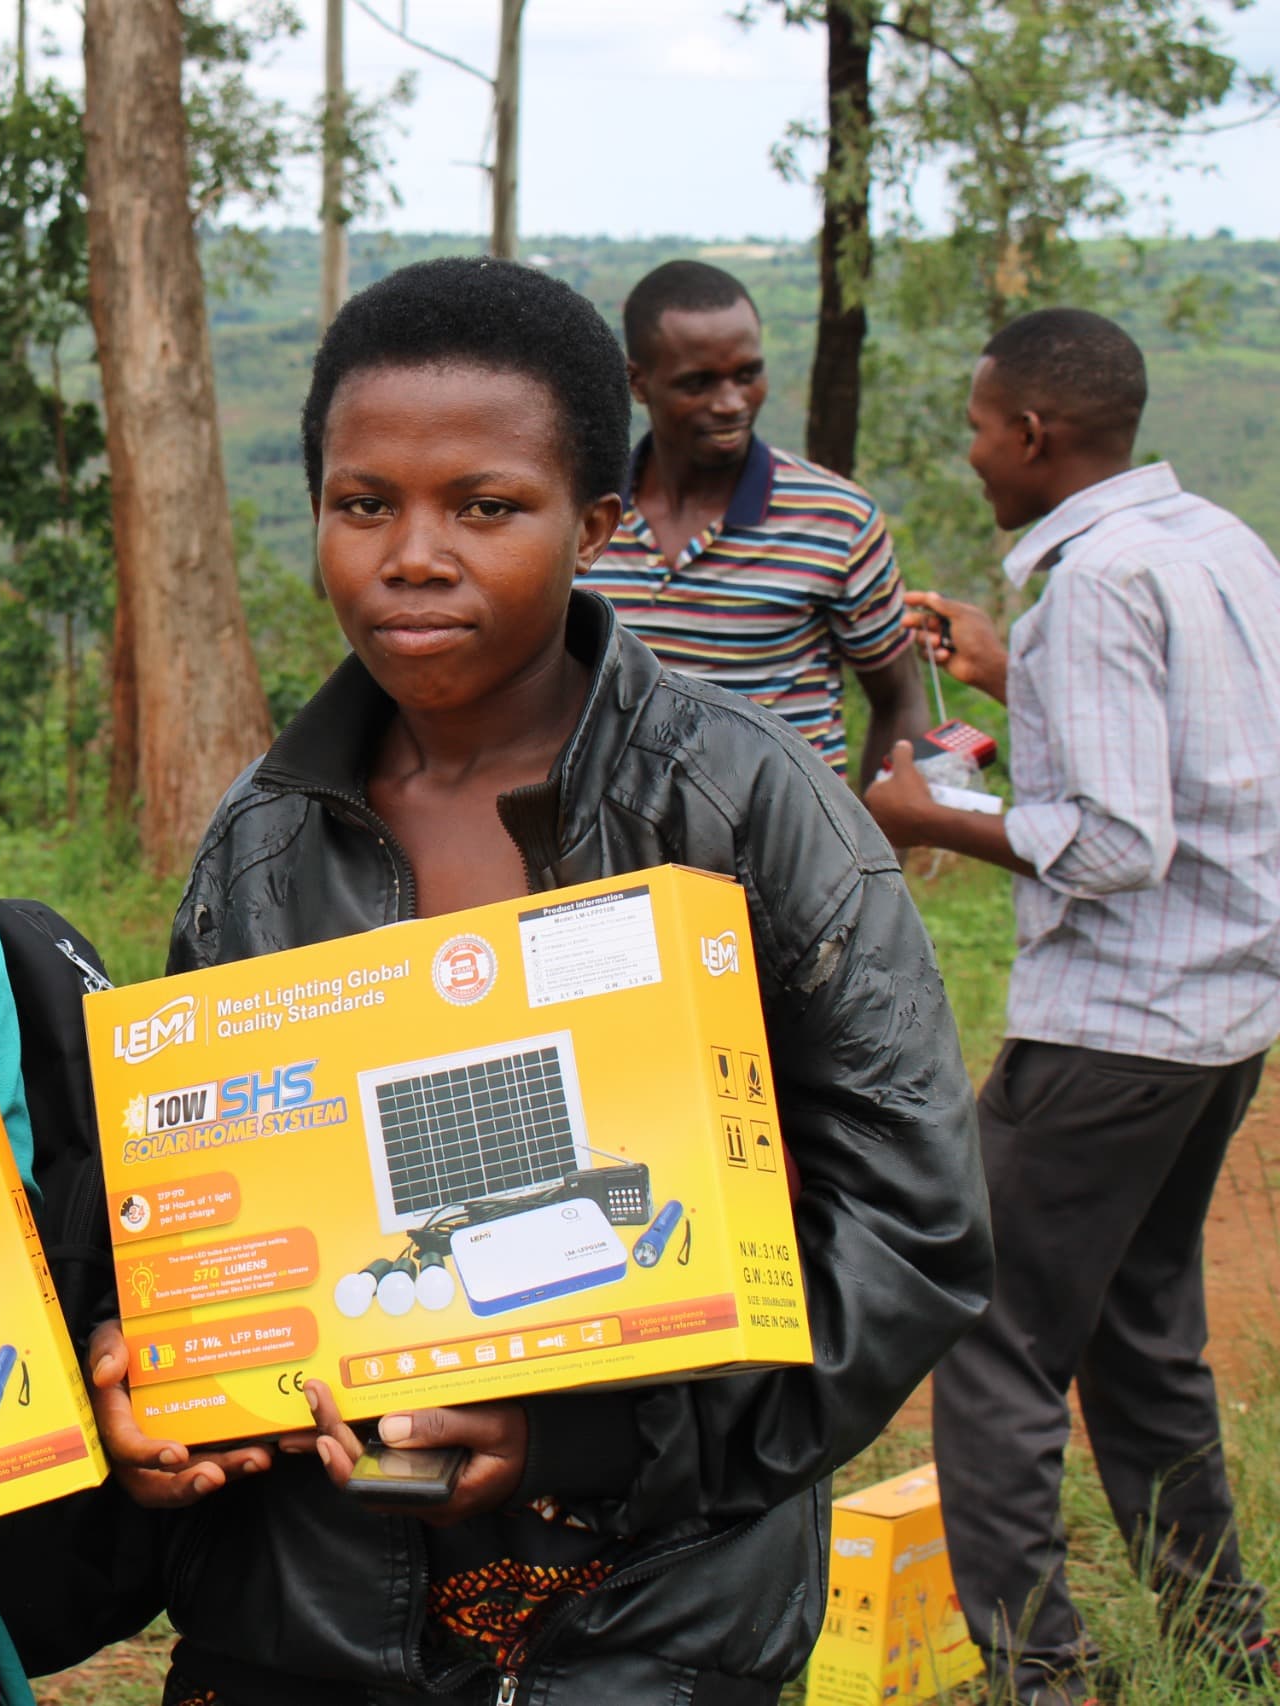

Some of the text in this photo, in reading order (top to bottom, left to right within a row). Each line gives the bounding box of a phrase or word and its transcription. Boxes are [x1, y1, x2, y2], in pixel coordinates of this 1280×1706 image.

[543, 893, 624, 916] Product information
[700, 930, 740, 976] LEMI
[217, 960, 410, 1018] Meet Lighting Global
[217, 989, 385, 1038] Quality Standards
[113, 995, 200, 1064] LEMI
[154, 1059, 319, 1128] 10W SHS
[122, 1098, 347, 1165] SOLAR HOME SYSTEM
[129, 1204, 146, 1220] 24
[172, 1200, 195, 1211] Hours
[198, 1197, 206, 1205] of
[214, 1192, 232, 1204] light
[160, 1208, 215, 1227] per full charge
[777, 1245, 789, 1261] KG
[193, 1259, 268, 1282] 570 LUMENS
[781, 1271, 793, 1286] KG
[751, 1314, 799, 1328] MADE IN CHINA
[184, 1340, 198, 1352] 51
[230, 1331, 252, 1345] LFP
[255, 1326, 292, 1341] Battery
[145, 1395, 226, 1416] No. LM-LFP010B
